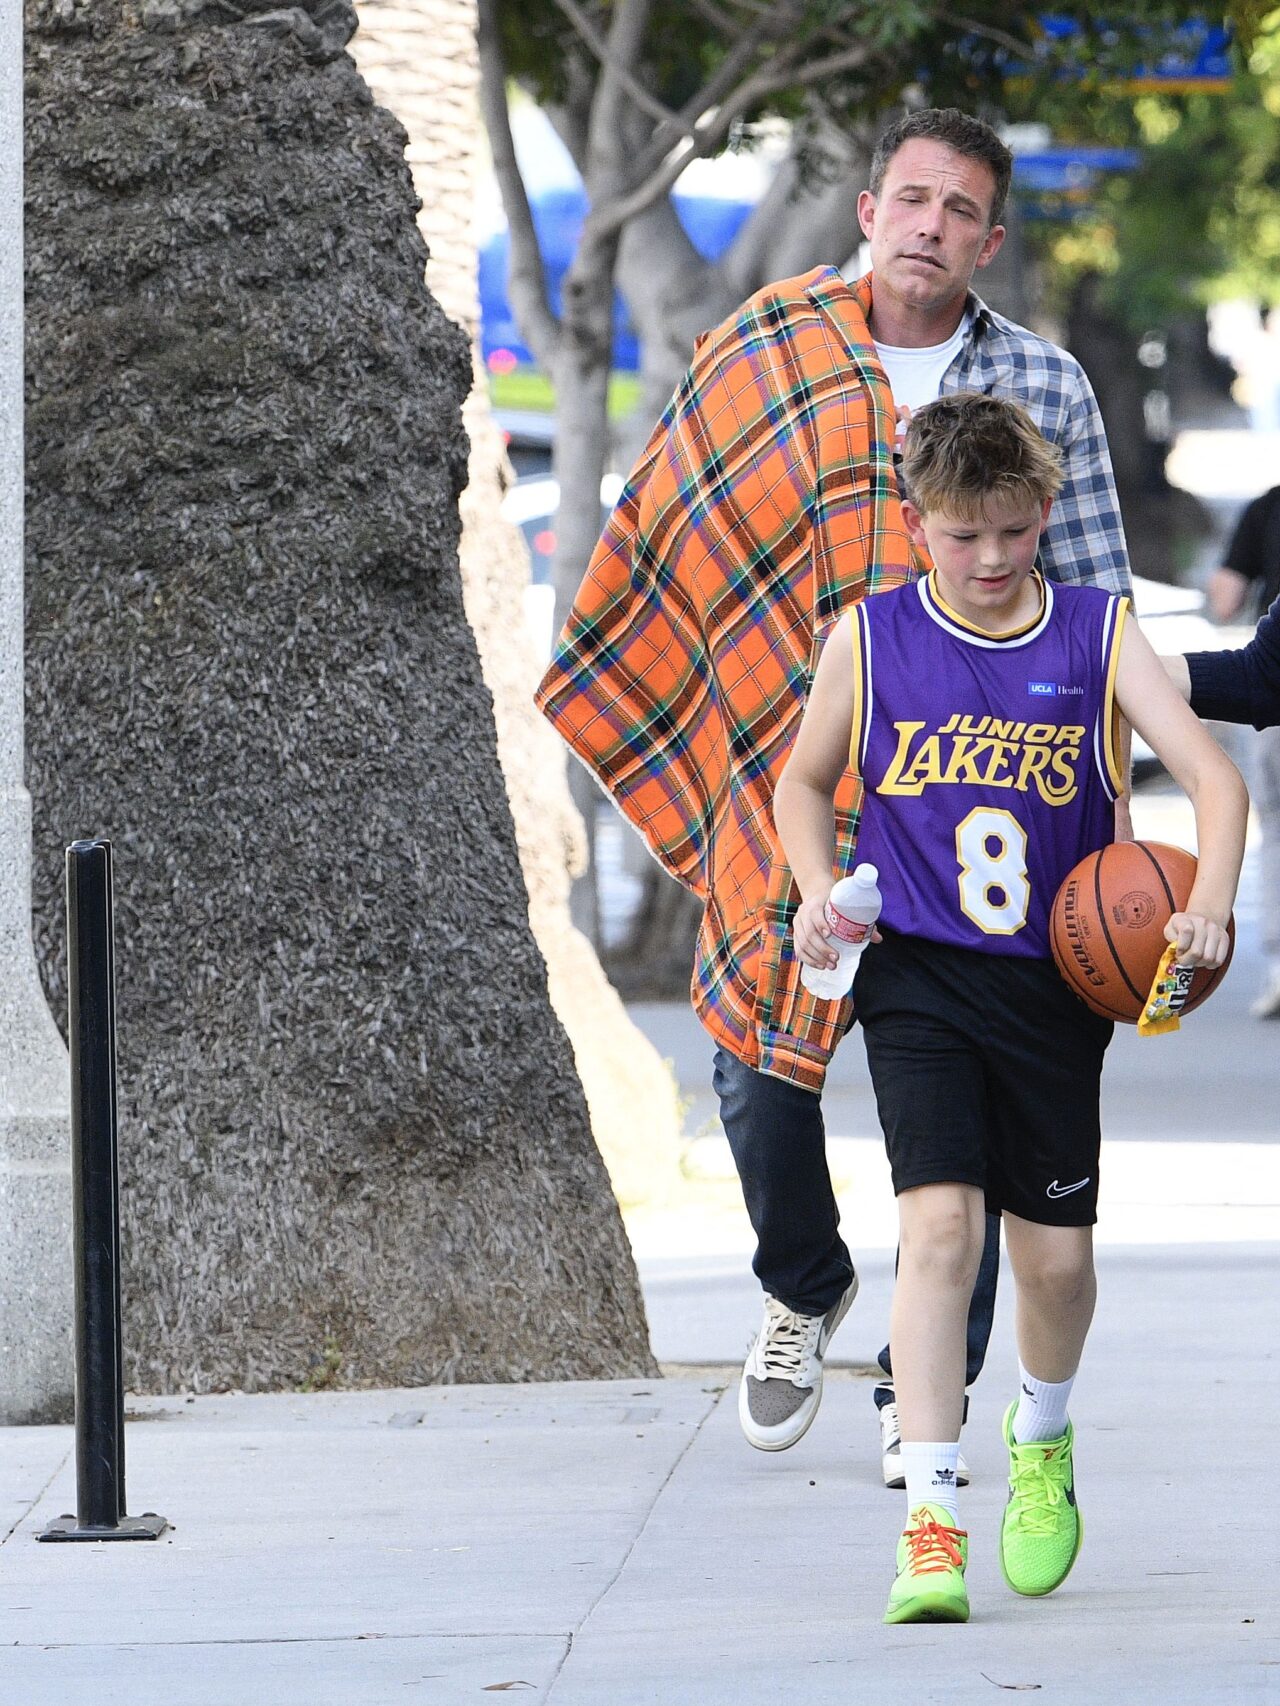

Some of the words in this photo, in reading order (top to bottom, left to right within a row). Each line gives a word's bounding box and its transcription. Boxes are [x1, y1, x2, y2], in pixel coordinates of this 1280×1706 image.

[937, 713, 1087, 746] JUNIOR
[1031, 684, 1052, 694] UCLA
[1057, 685, 1084, 695] Health
[875, 720, 1081, 807] LAKERS
[955, 806, 1031, 936] 8
[1064, 880, 1106, 986] EVOLUTION
